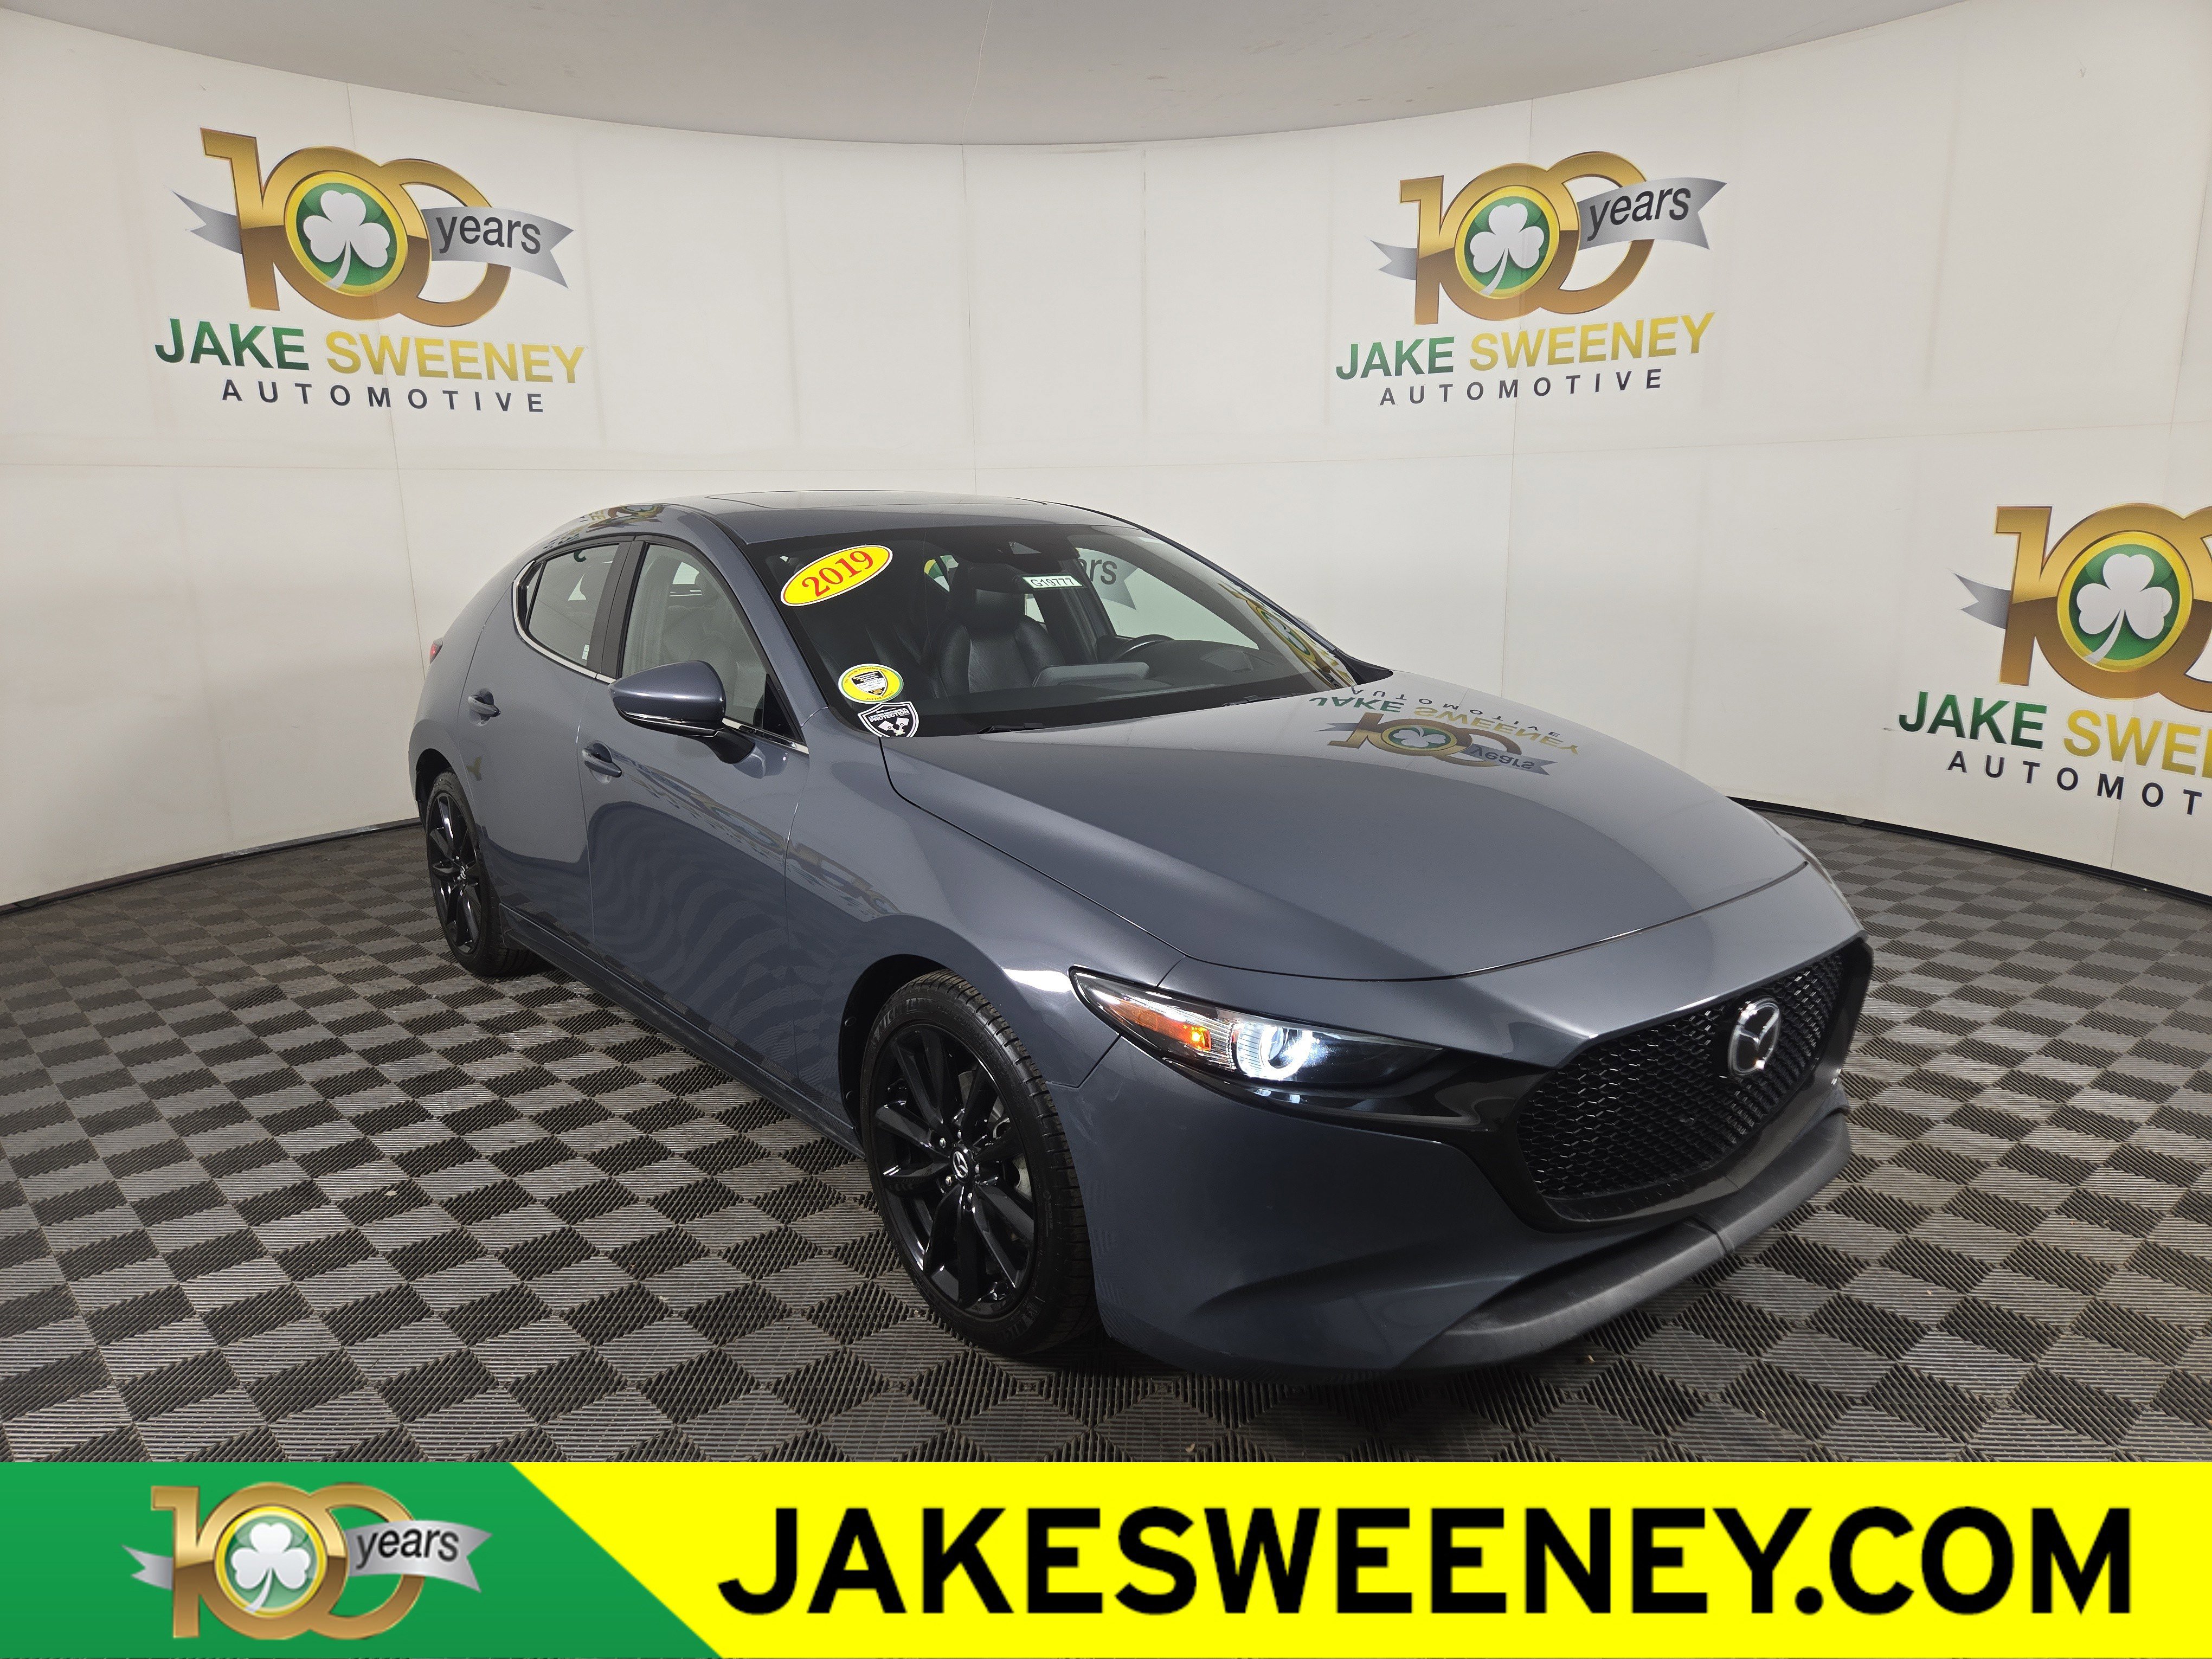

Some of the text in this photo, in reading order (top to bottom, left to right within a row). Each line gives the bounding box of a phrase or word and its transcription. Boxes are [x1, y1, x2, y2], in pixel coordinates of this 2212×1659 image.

[436, 215, 541, 255] years
[1587, 186, 1691, 241] years
[155, 318, 585, 384] JAKE SWEENEY
[1336, 312, 1715, 381] JAKE SWEENEY
[222, 379, 544, 413] AUTOMOTIVE
[1380, 368, 1662, 406] AUTOMOTIVE
[802, 551, 873, 597] 2019
[1031, 578, 1075, 587] G19777
[1899, 691, 2047, 750] JAKE
[1948, 750, 2202, 815] AUTOMOT
